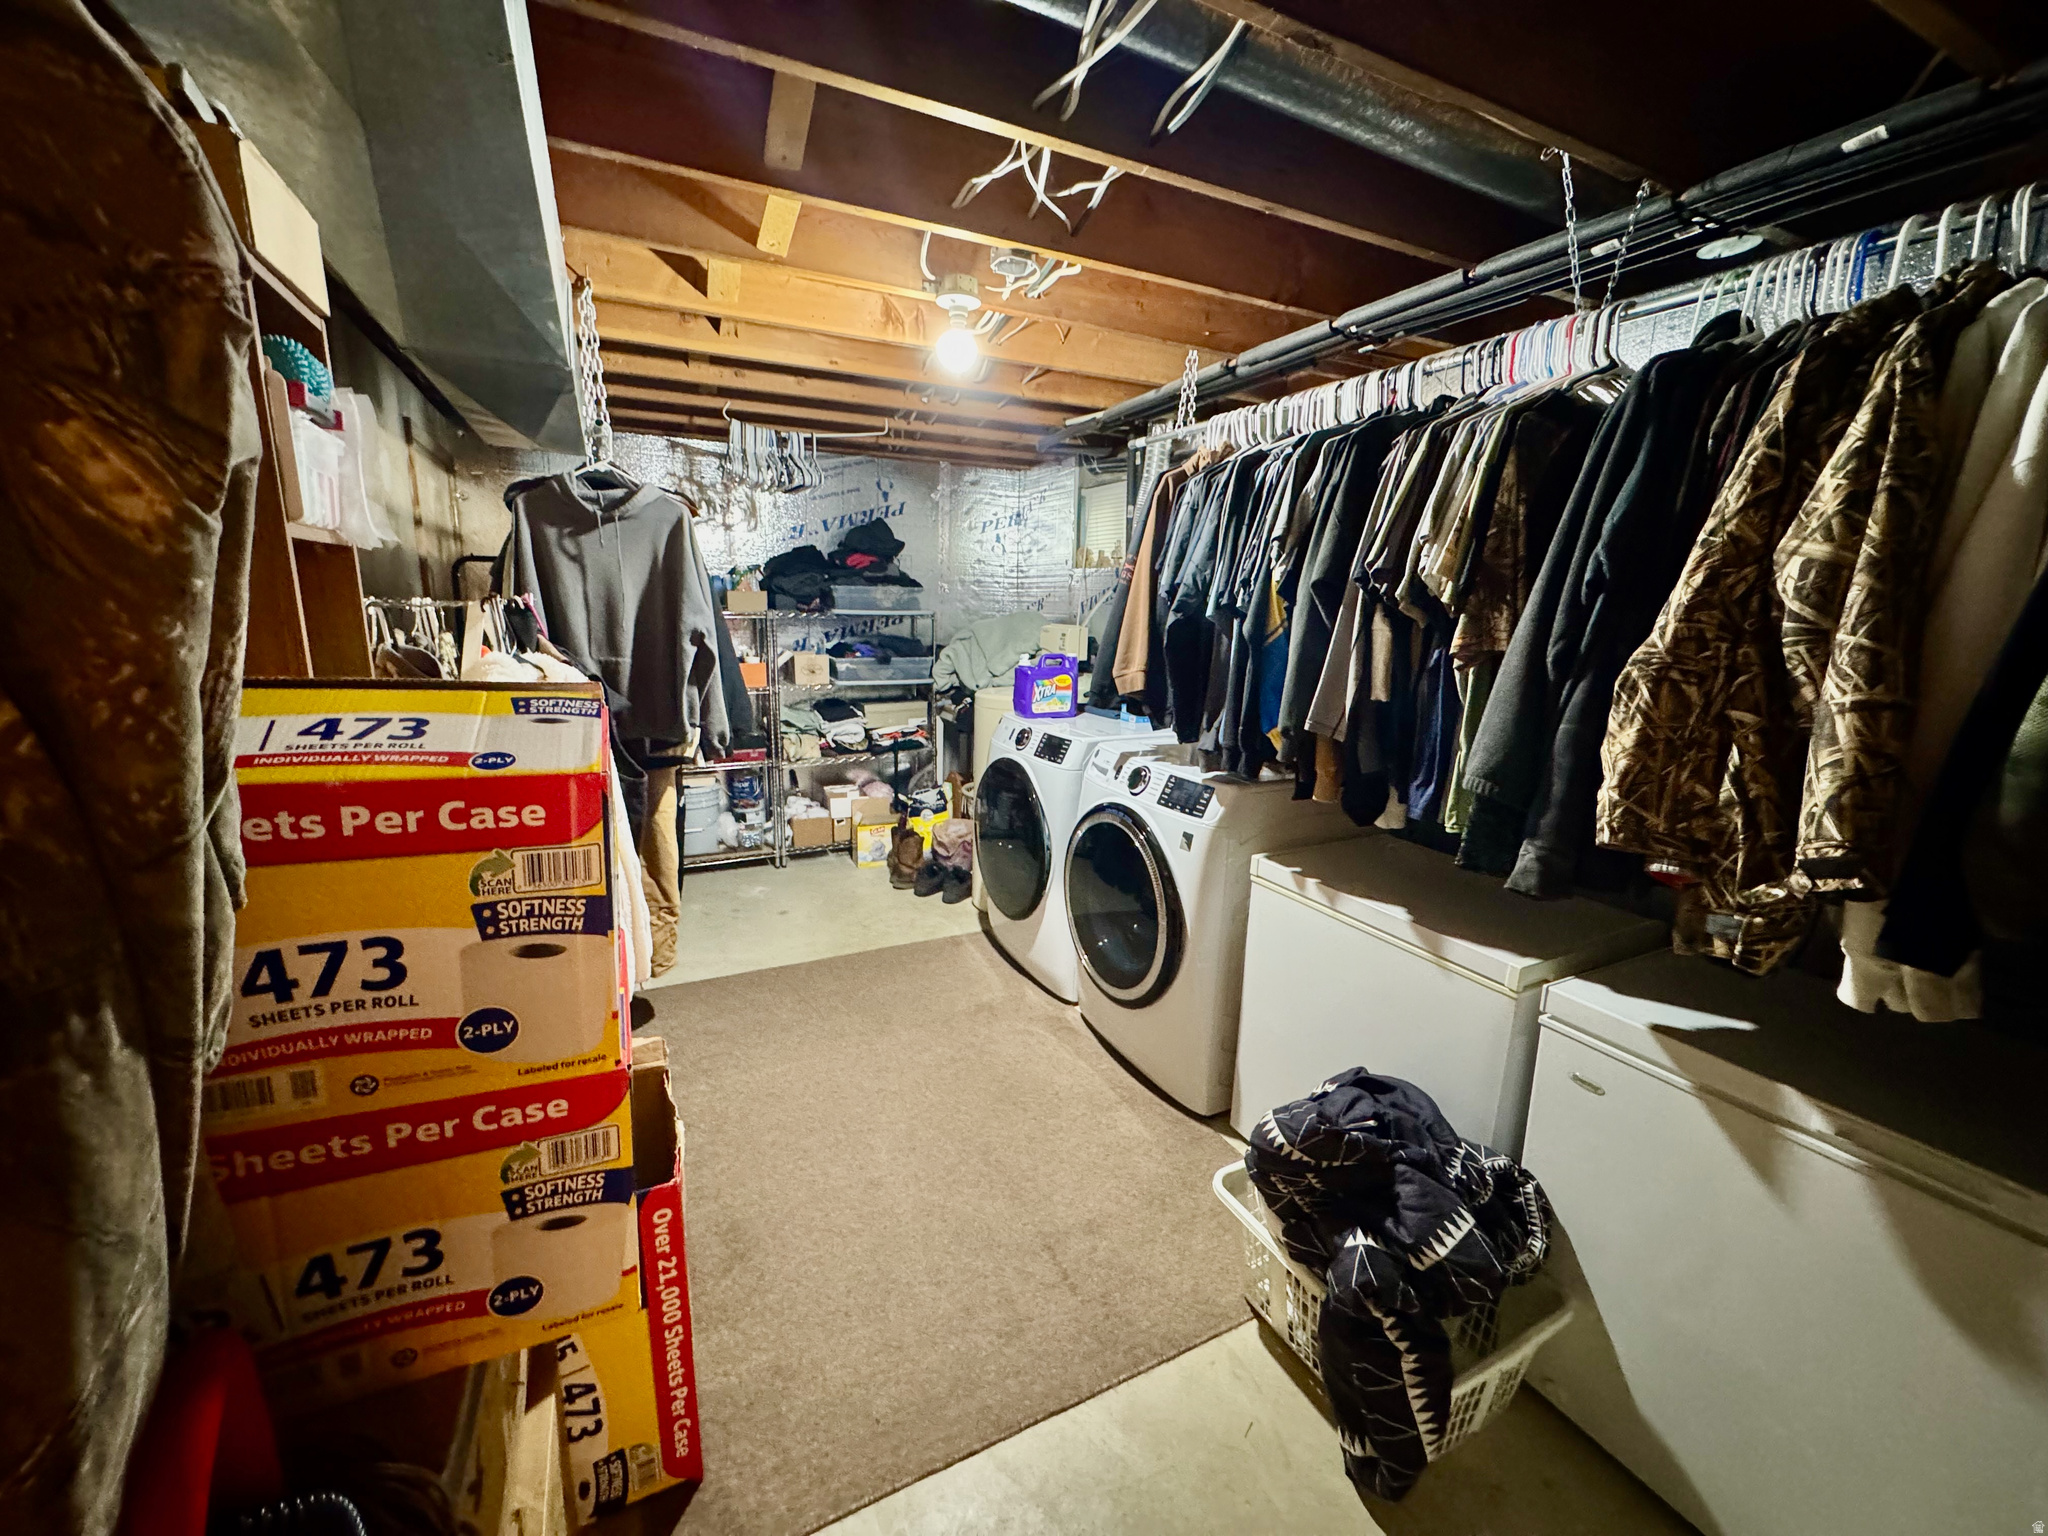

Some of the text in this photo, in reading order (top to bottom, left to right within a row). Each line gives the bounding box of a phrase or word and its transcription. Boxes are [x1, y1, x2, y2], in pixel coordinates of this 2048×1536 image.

[529, 699, 600, 709] SOFTNESS
[1032, 683, 1057, 704] XTRA
[529, 707, 598, 716] STRENGTH
[297, 717, 430, 741] 473
[285, 743, 348, 751] SHEETS
[388, 742, 426, 750] ROLL
[253, 754, 449, 765] INDIVIDUALLY WRAPPED
[474, 756, 514, 765] 2-PLY
[241, 800, 546, 842] ets Per Case
[480, 878, 512, 888] SCAN
[481, 887, 512, 897] HERE
[496, 898, 587, 919] SOFTNESS
[500, 917, 585, 935] STRENGTH
[241, 936, 408, 1004] 473
[249, 995, 419, 1028] SHEETS PER ROLL
[463, 1020, 514, 1040] 2-PLY
[221, 1028, 432, 1067] DIVIDUALLY WRAPPED
[517, 1054, 607, 1076] Labeled for resale
[386, 1117, 460, 1148] Per
[472, 1098, 569, 1131] Case
[524, 1172, 606, 1201] SOFTNESS
[526, 1188, 603, 1214] STRENGTH
[295, 1228, 444, 1299] 473
[411, 1275, 454, 1292] ROLL
[493, 1285, 540, 1308] 2-PLY
[652, 1207, 692, 1458] Over 21,000 Sheets Per Case
[564, 1383, 603, 1442] 473
